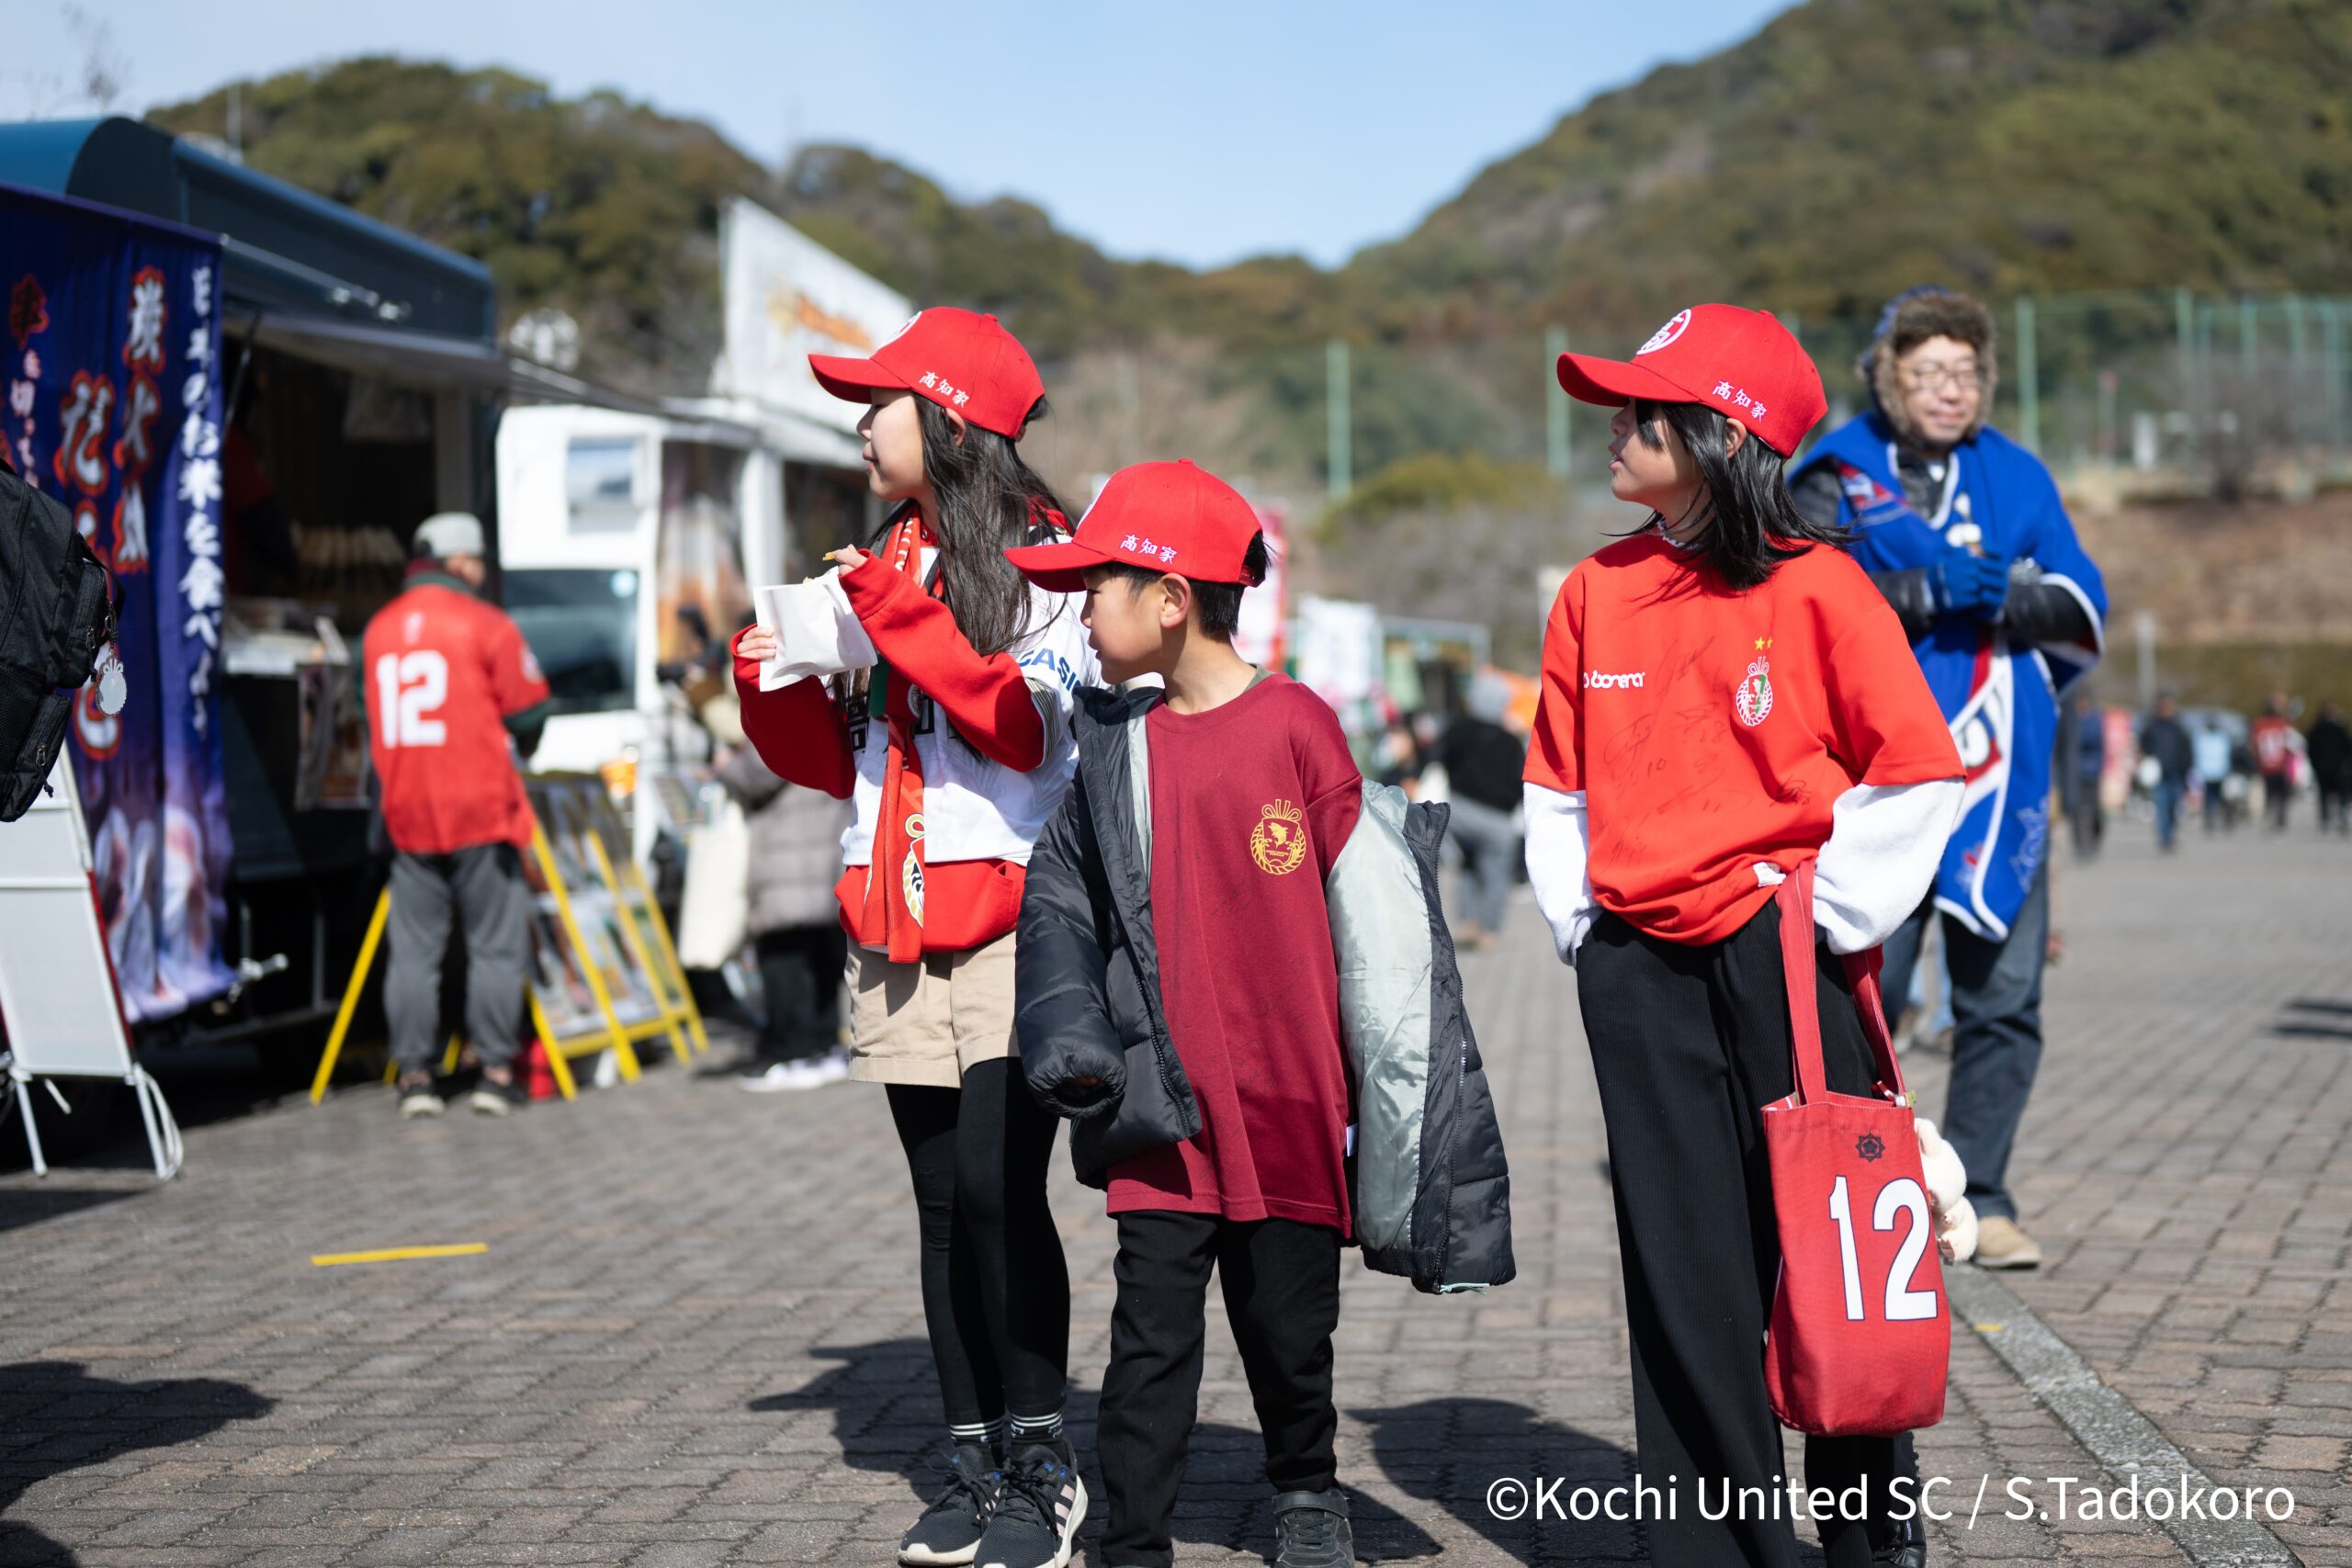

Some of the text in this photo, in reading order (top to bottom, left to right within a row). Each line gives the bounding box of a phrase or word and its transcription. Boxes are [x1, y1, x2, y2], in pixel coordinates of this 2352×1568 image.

[919, 370, 970, 408] 高知家
[1712, 380, 1768, 423] 高知家
[1119, 534, 1177, 565] 高知家
[1018, 648, 1082, 692] CASI
[376, 650, 447, 750] 12
[1828, 1175, 1938, 1321] 12
